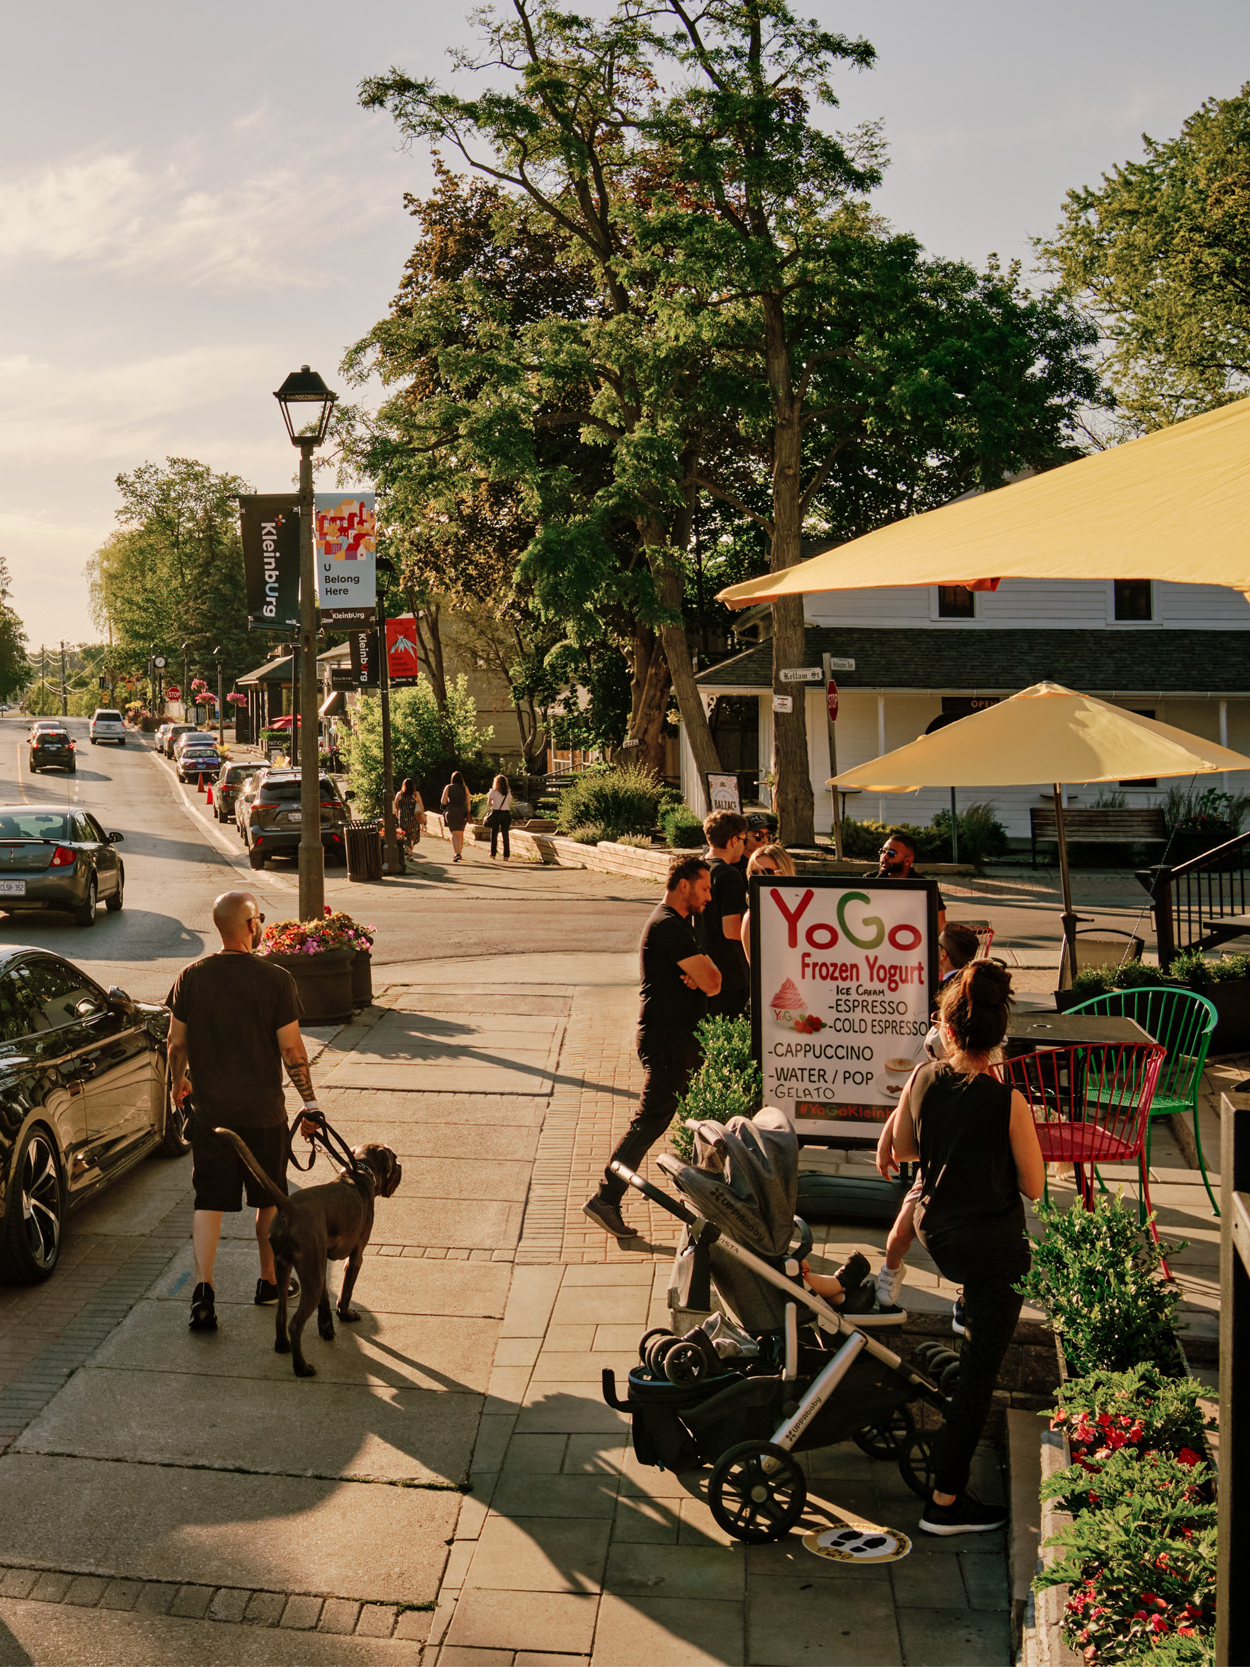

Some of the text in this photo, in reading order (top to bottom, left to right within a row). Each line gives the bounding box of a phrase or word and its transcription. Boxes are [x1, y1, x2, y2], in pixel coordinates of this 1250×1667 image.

[325, 575, 360, 584] Belong
[325, 587, 349, 595] Here
[783, 670, 820, 681] Kellam St
[828, 694, 838, 708] STOP
[770, 888, 922, 951] YoGo
[801, 952, 925, 992] Frozen Yogurt
[836, 984, 885, 997] ICE CREAM
[871, 1019, 928, 1036] ESPRESSO
[843, 1070, 874, 1085] POP
[792, 1396, 822, 1433] UPPAbaby
